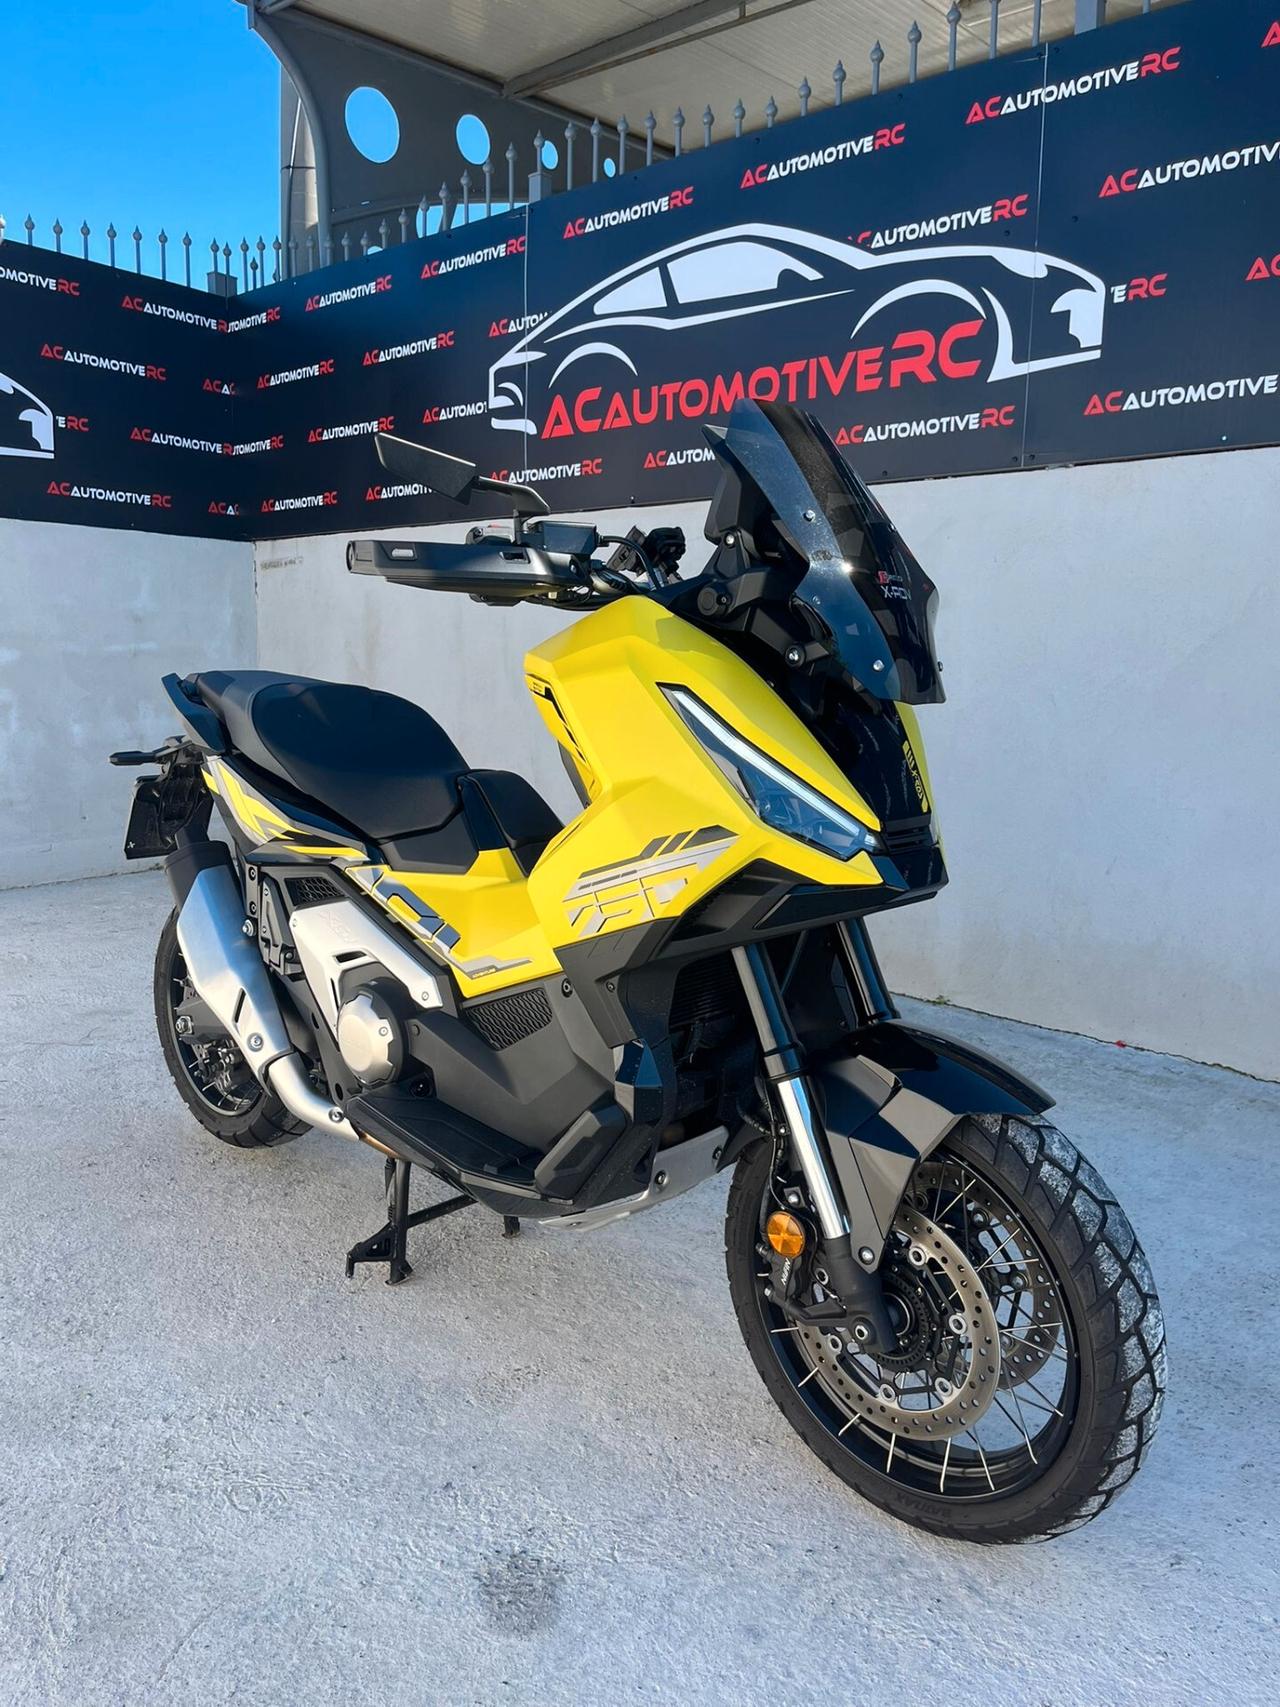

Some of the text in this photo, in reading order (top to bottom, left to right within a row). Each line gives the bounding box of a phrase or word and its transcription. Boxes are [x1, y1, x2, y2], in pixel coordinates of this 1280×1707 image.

[966, 46, 1181, 124] ACAUTOMOTIVERC
[741, 123, 906, 189] ACAUTOMOTIVERC
[1099, 141, 1280, 198] ACAUTOMOTIV
[563, 186, 694, 240] ACAUTOMOTIVERC
[421, 236, 526, 280] ACAUTOMOTIVERC
[305, 275, 393, 312] ACAUTOMOTIVERC
[40, 343, 167, 382] ACAUTOMOTIVERC
[362, 330, 455, 366] ACAUTOMOTIVERC
[257, 359, 334, 389] ACAUTOMOTIVERC
[541, 319, 985, 440] ACAUTOMOTIVERC
[1083, 374, 1279, 416] ACAUTOMOTIVE
[308, 416, 395, 443] ACAUTOMOTIVERC
[835, 405, 1015, 446] ACAUTOMOTIVERC
[47, 481, 173, 508] ACAUTOMOTIVERC
[261, 490, 338, 513] ACAUTOMOTIVERC
